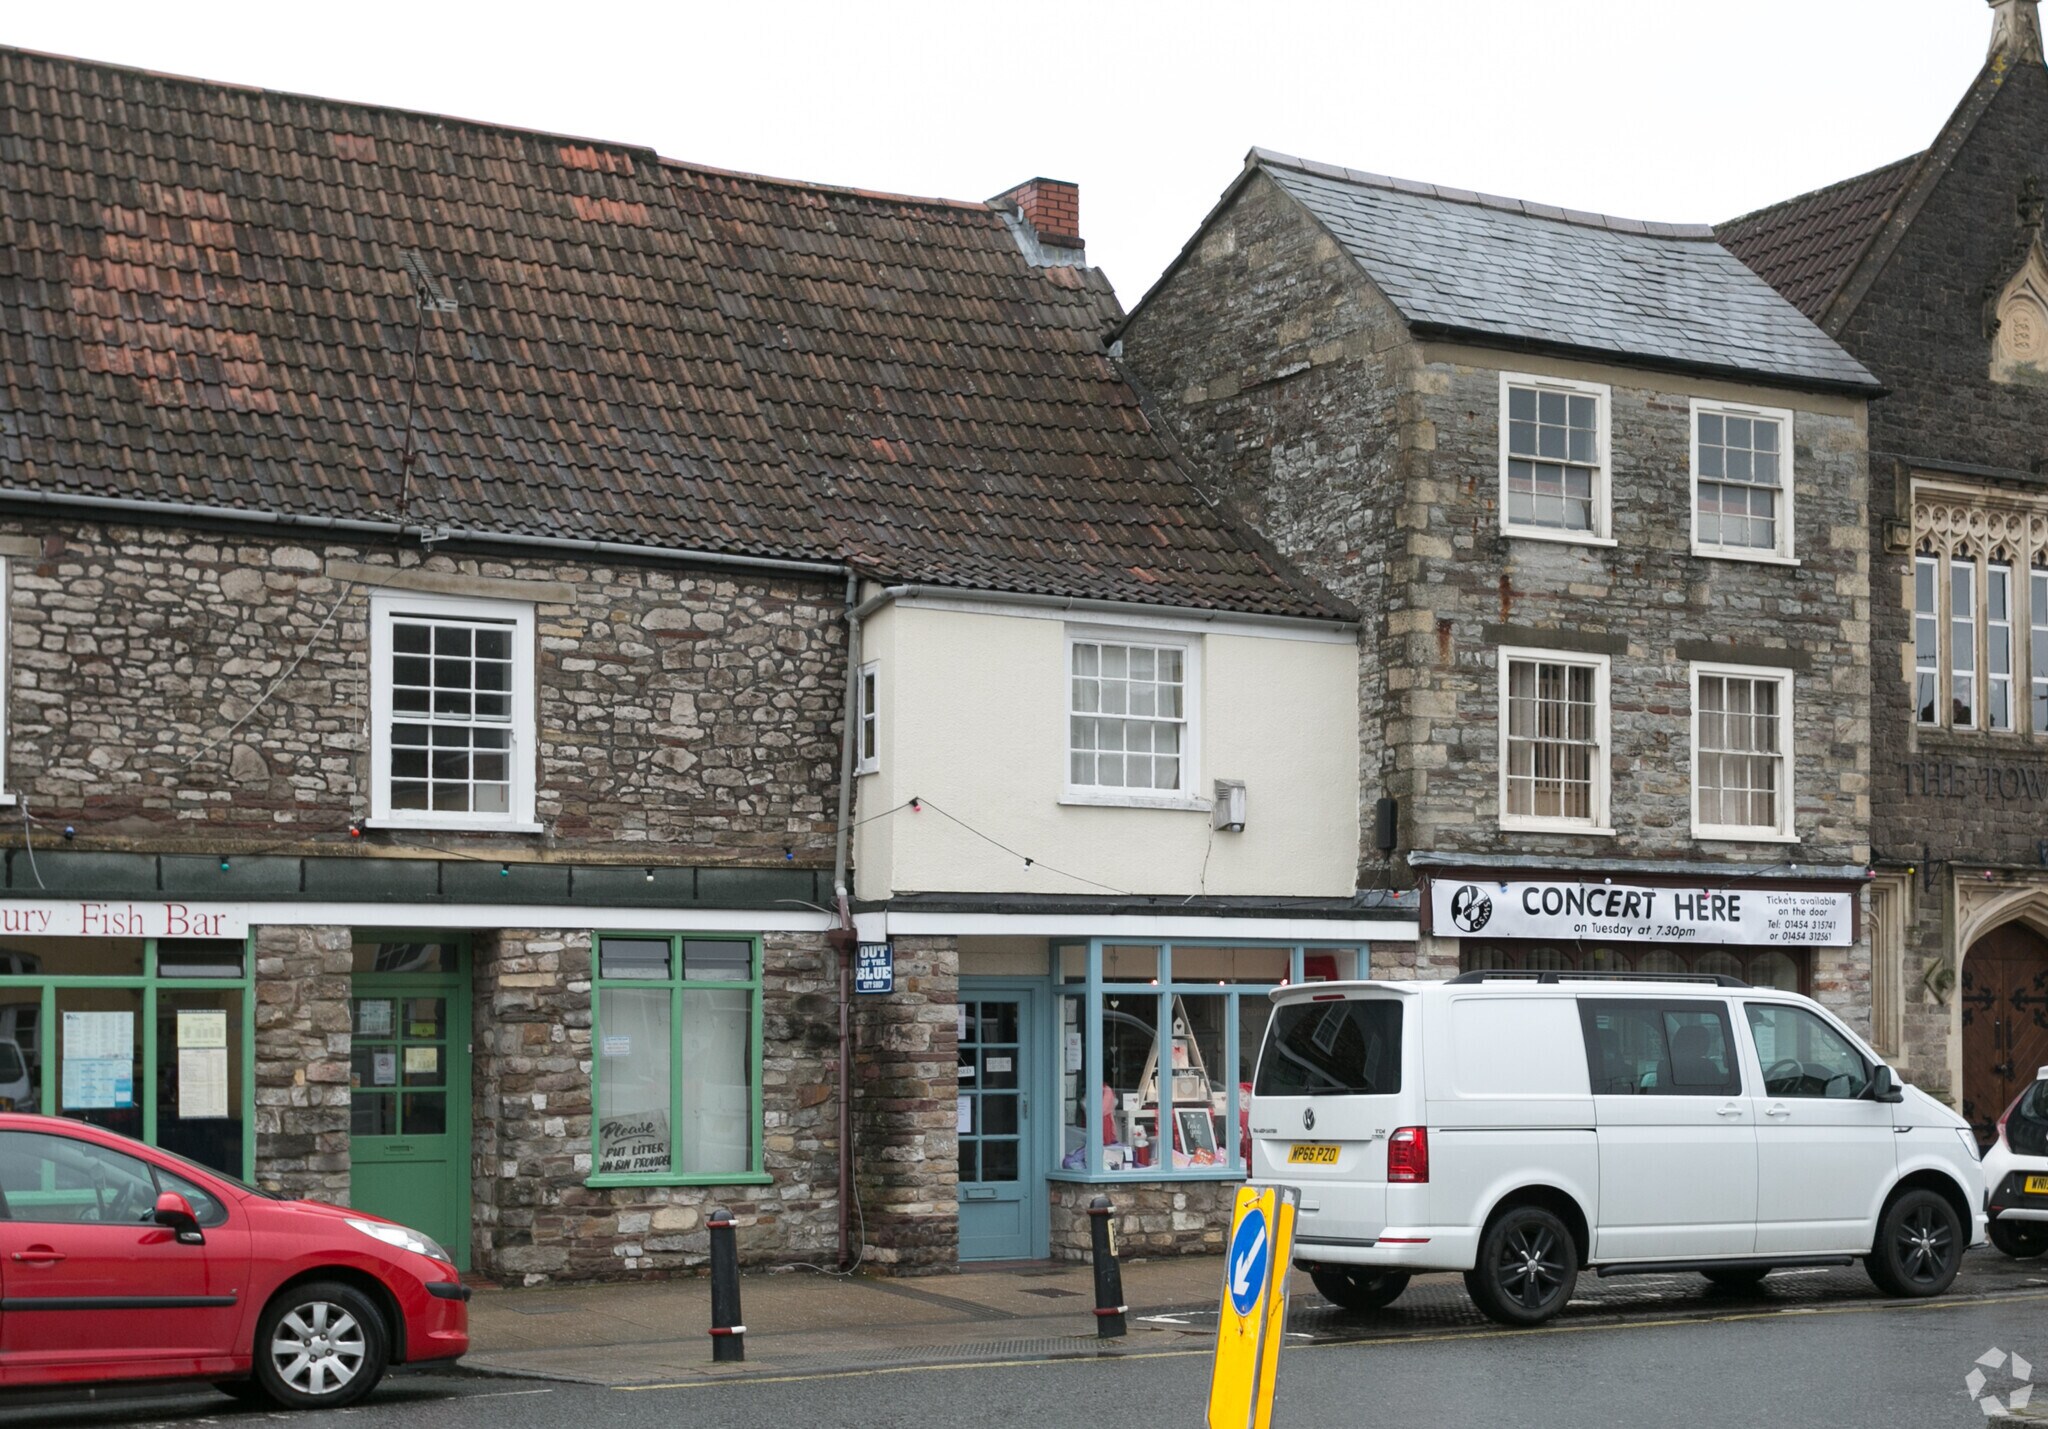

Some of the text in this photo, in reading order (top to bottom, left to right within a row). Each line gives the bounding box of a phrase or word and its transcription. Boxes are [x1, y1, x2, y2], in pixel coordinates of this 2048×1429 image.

[1900, 762, 1967, 798] THE
[1522, 887, 1740, 922] CONCERT HERE
[1766, 896, 1837, 906] Tickets available
[0, 903, 226, 936] ury Fish Bar
[1473, 901, 1491, 929] CSMS
[1778, 908, 1828, 917] on the door
[1574, 923, 1696, 938] on Tuesday at 7.30pm
[1767, 920, 1837, 930] Tel: 01454 315741
[1782, 932, 1806, 941] 01454
[1809, 932, 1832, 941] 312561
[860, 945, 888, 958] OUT
[861, 958, 886, 967] OF THE
[857, 966, 891, 980] BLUE
[600, 1121, 655, 1139] Please
[606, 1142, 664, 1158] PUT LITTER
[1292, 1146, 1314, 1161] WP66
[601, 1161, 613, 1172] IN
[615, 1159, 631, 1170] BIN
[2031, 1177, 2048, 1189] WN1
